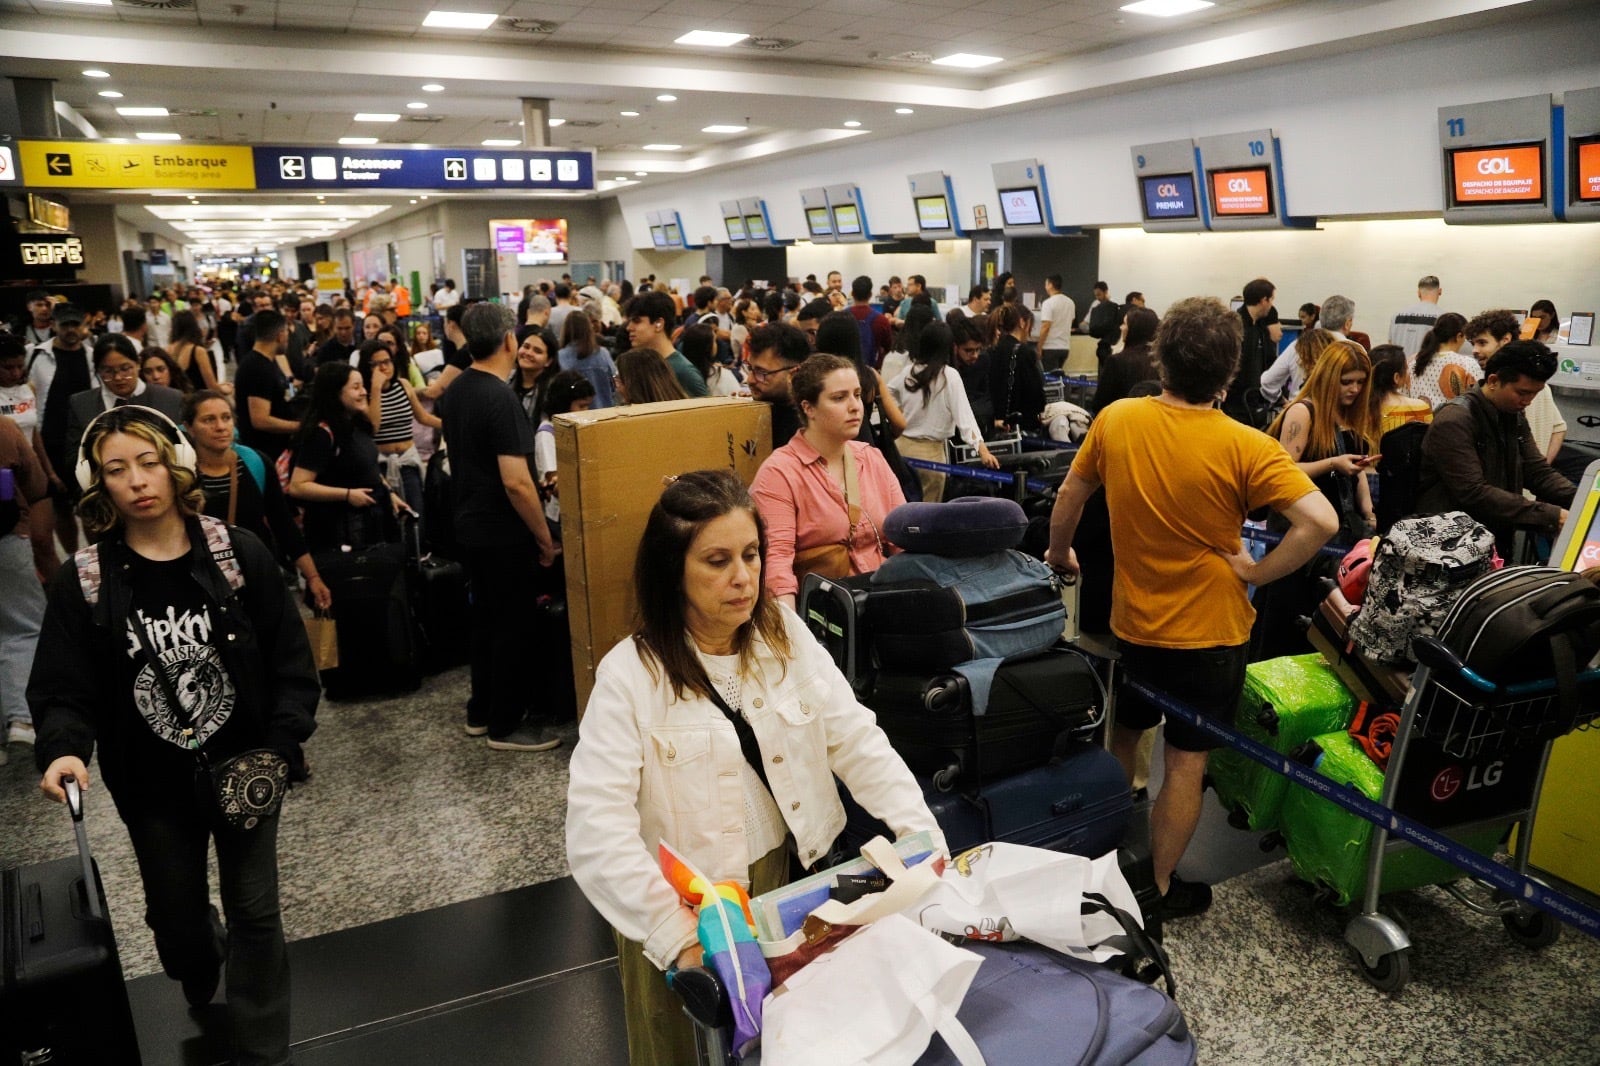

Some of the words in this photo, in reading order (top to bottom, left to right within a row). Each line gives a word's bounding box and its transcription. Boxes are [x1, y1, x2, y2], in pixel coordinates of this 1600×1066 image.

[1446, 117, 1465, 137] 11
[1248, 140, 1265, 156] 10
[153, 155, 228, 169] Embarque
[1136, 155, 1146, 169] 9
[1477, 157, 1515, 175] GOL
[154, 170, 199, 179] Boarding
[201, 171, 222, 179] area
[1026, 167, 1034, 179] 8
[1157, 183, 1179, 198] GOL
[1228, 178, 1252, 193] GOL
[1156, 201, 1184, 209] PREMIUM
[212, 692, 237, 727] IOWA
[1295, 770, 1330, 793] despegar
[1466, 760, 1504, 791] LG
[1405, 826, 1449, 854] despegar
[1542, 896, 1600, 929] despegar
